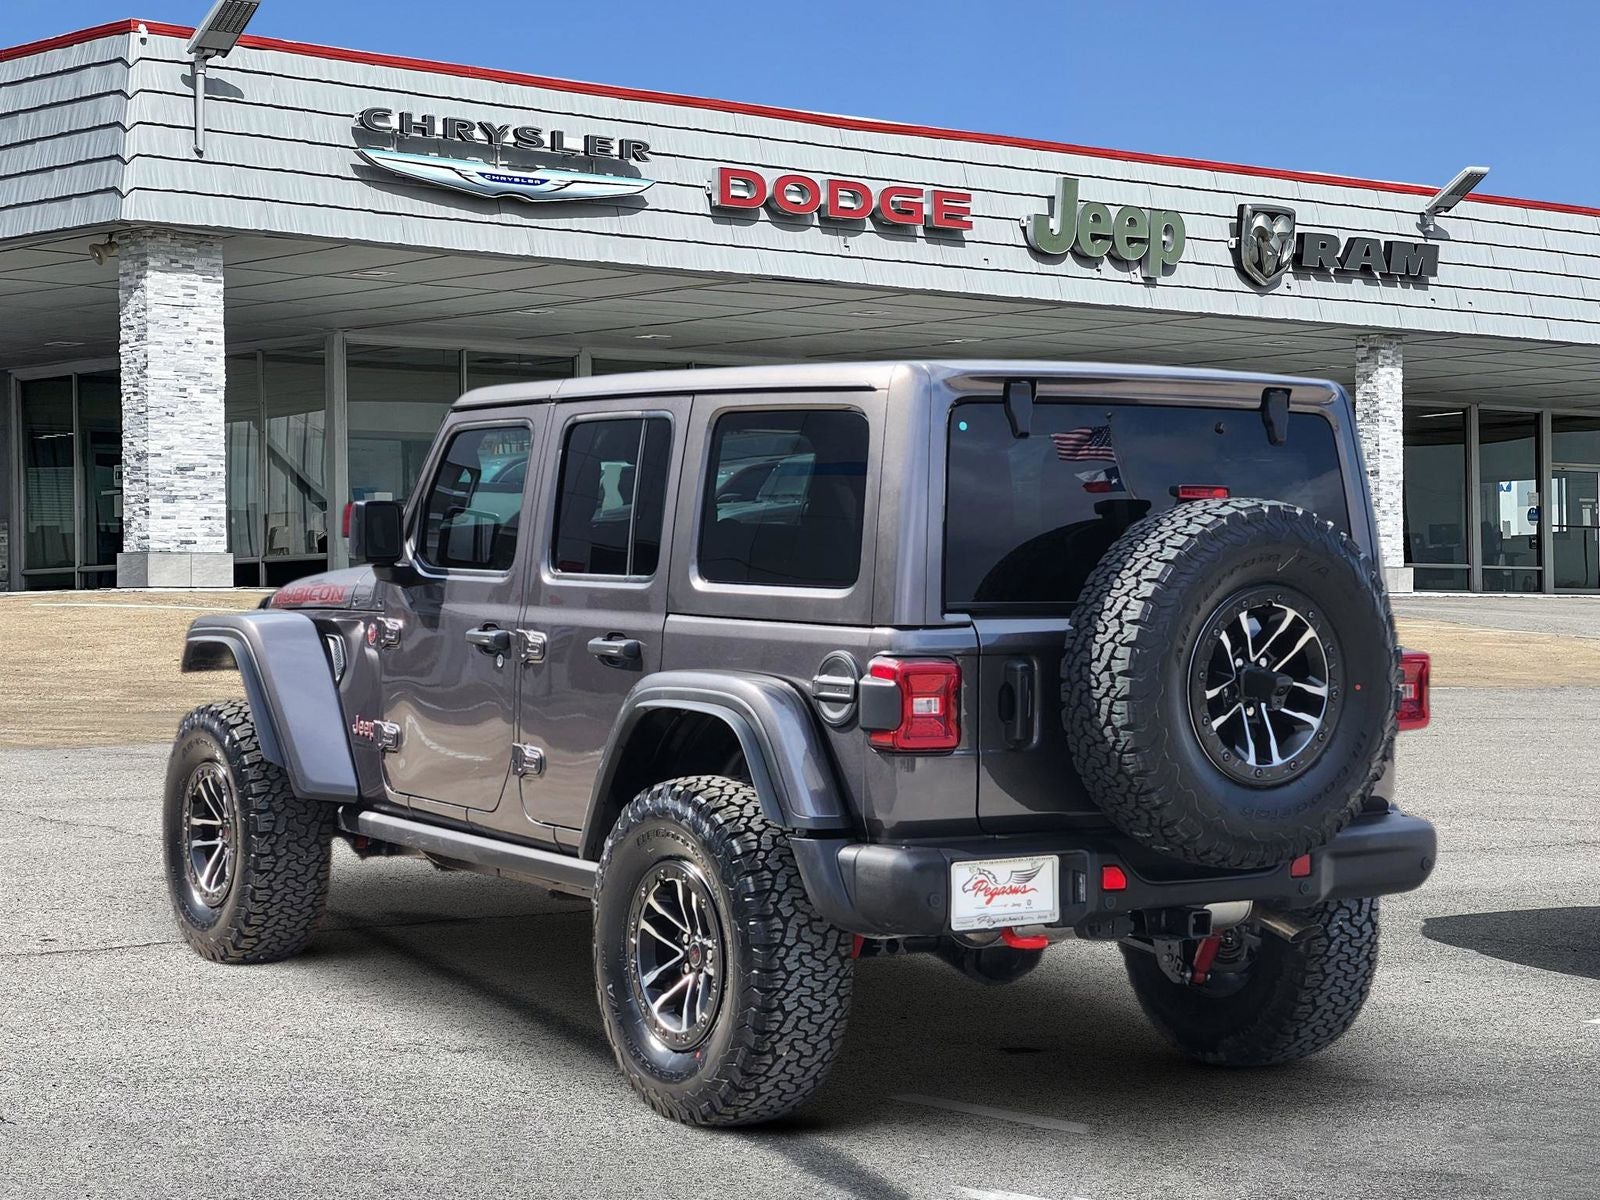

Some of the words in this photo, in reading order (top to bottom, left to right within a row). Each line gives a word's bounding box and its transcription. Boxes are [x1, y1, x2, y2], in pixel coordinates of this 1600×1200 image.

[357, 107, 651, 162] CHRYSLER
[484, 174, 541, 184] CHRYSLER
[714, 166, 973, 231] DODGE
[1027, 177, 1186, 279] Jeep
[1298, 232, 1440, 277] RAM
[275, 583, 347, 604] RUBICON
[352, 714, 374, 741] Jeep
[972, 879, 1038, 906] Pegasus
